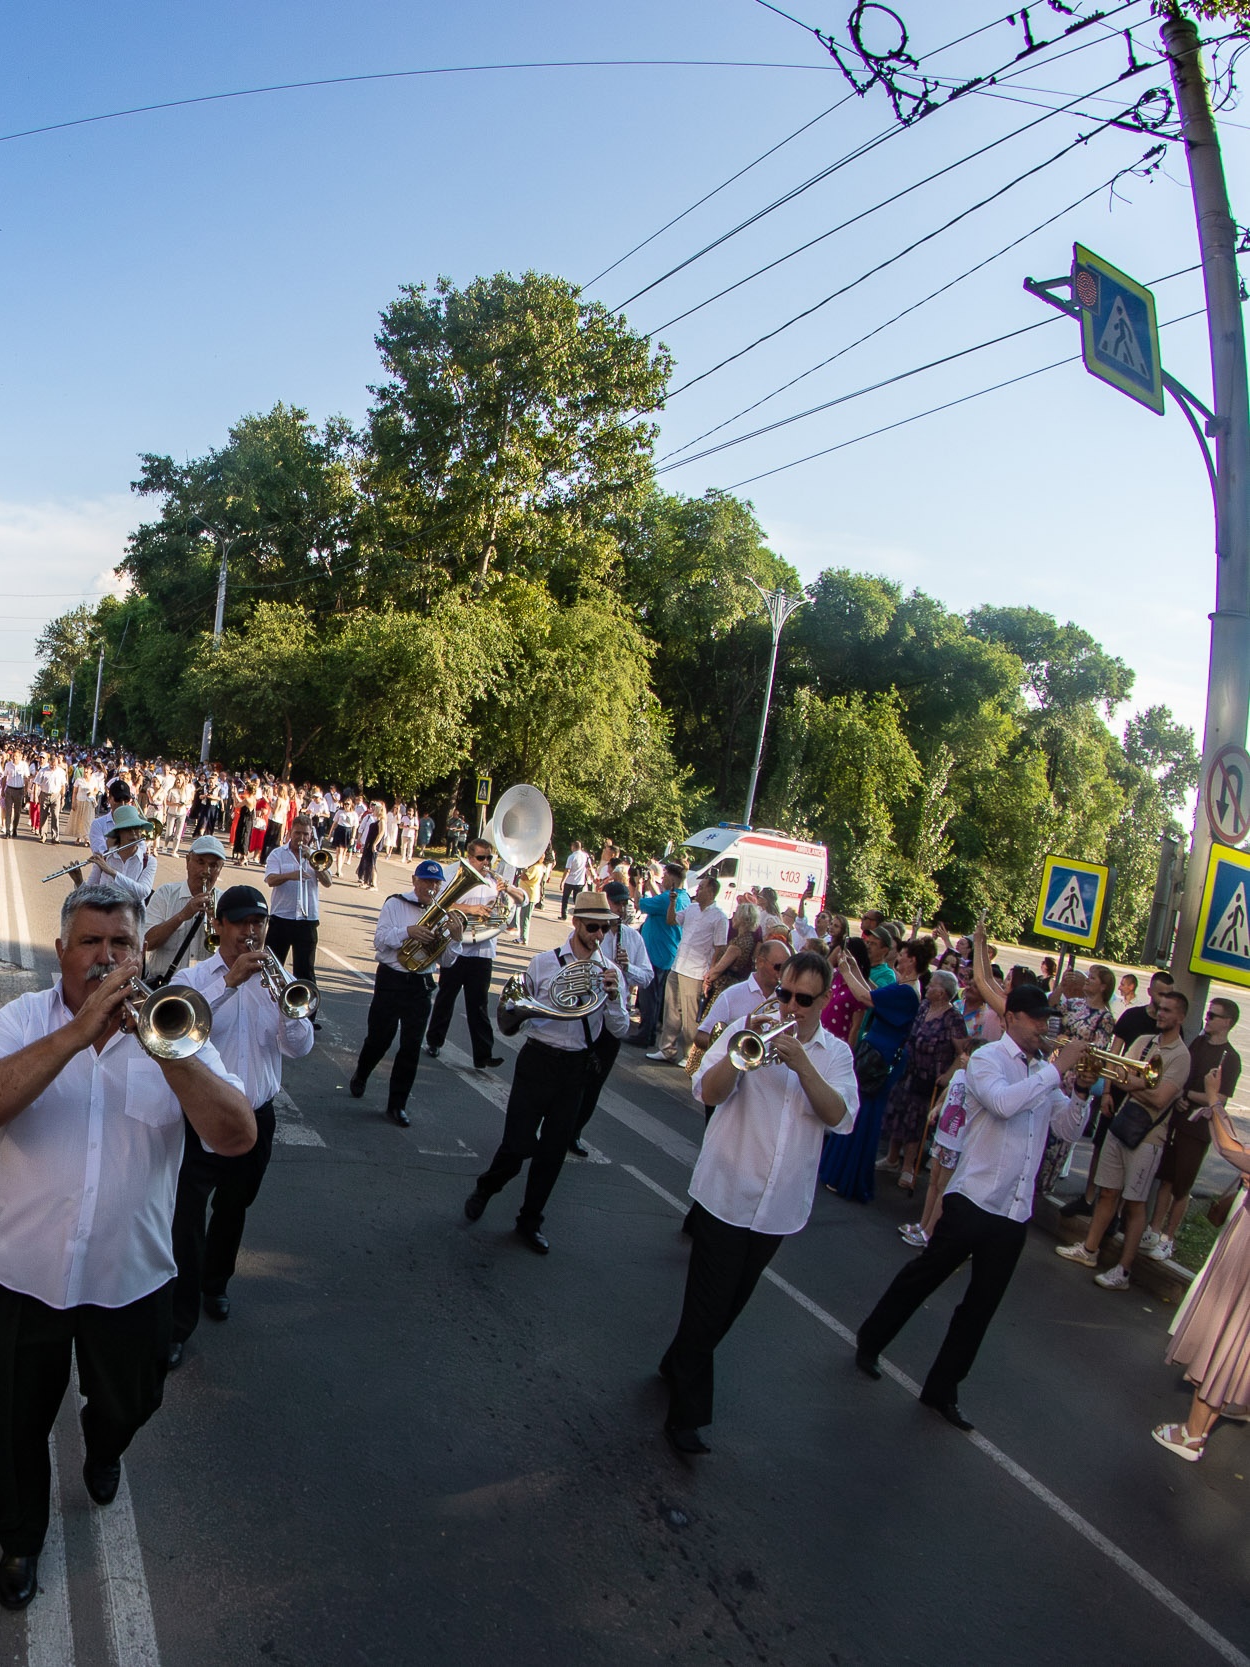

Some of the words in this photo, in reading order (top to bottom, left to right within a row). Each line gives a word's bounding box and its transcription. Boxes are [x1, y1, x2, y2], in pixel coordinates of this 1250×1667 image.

[795, 846, 825, 857] AMBULANCE
[785, 870, 801, 884] 103
[724, 890, 733, 900] 11
